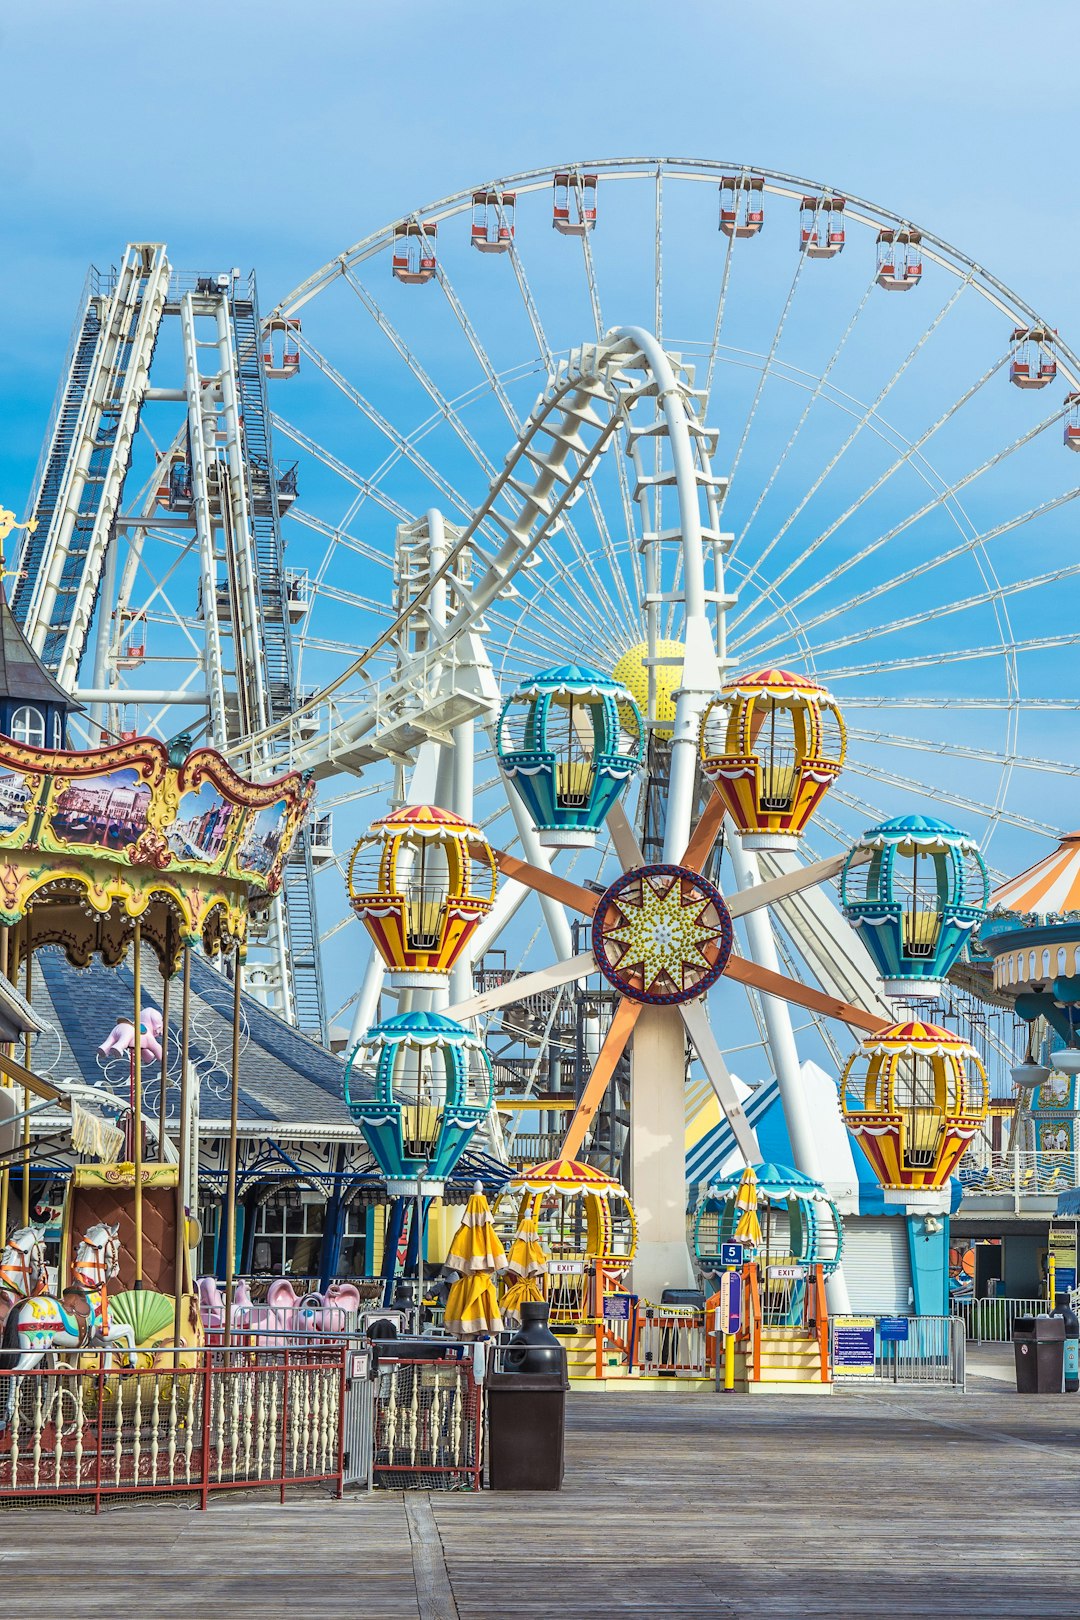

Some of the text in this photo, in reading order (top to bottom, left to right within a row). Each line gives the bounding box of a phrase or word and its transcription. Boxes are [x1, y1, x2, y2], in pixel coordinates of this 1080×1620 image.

[728, 1246, 736, 1257] 5
[663, 1308, 689, 1316] ENTER
[216, 1351, 233, 1362] EXT
[356, 1360, 364, 1372] EXIT
